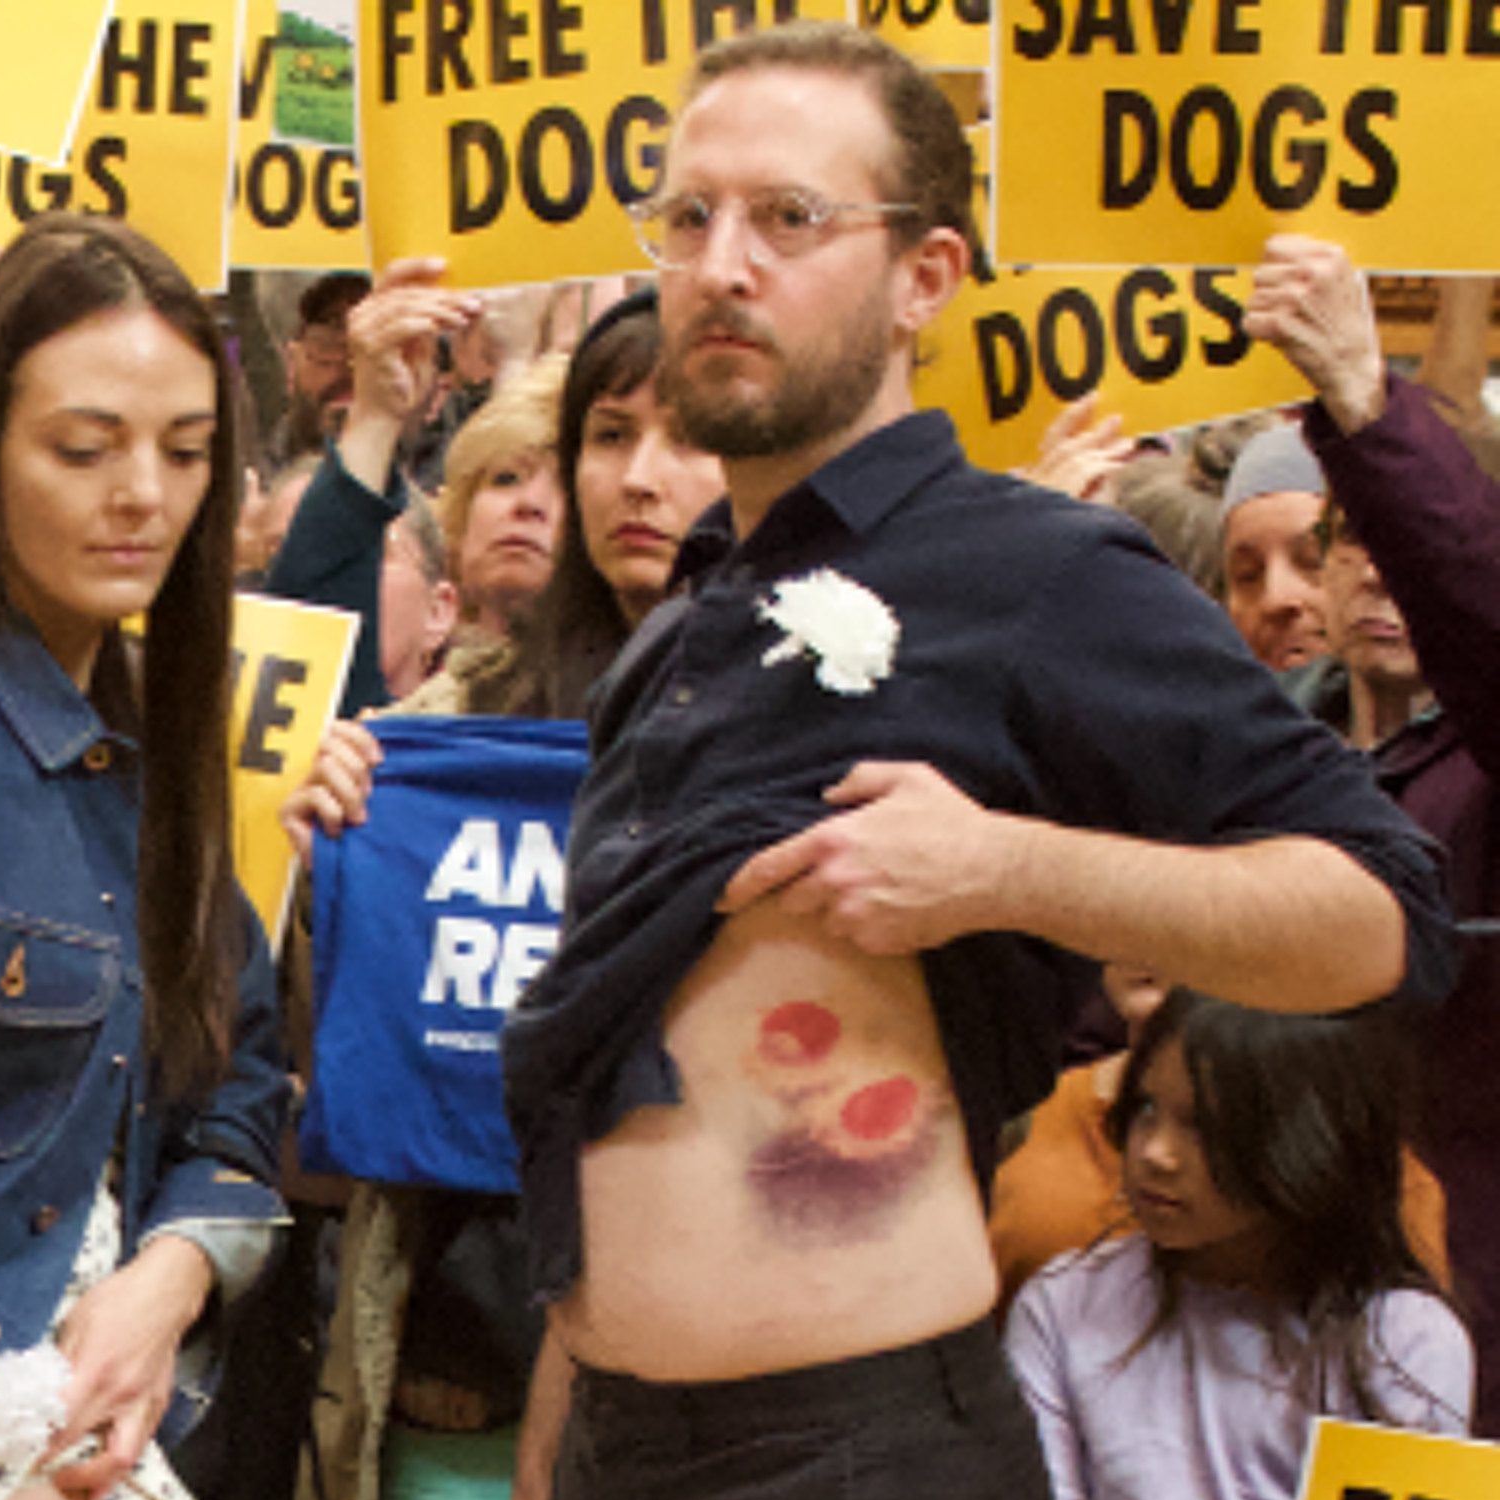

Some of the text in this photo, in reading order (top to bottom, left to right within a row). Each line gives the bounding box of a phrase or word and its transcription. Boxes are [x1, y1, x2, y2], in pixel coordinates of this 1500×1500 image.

[97, 18, 212, 115] HE
[380, 0, 587, 104] FREE
[234, 143, 361, 230] OG
[449, 96, 670, 234] DOG
[1102, 86, 1399, 213] DOGS
[974, 268, 1254, 422] DOGS
